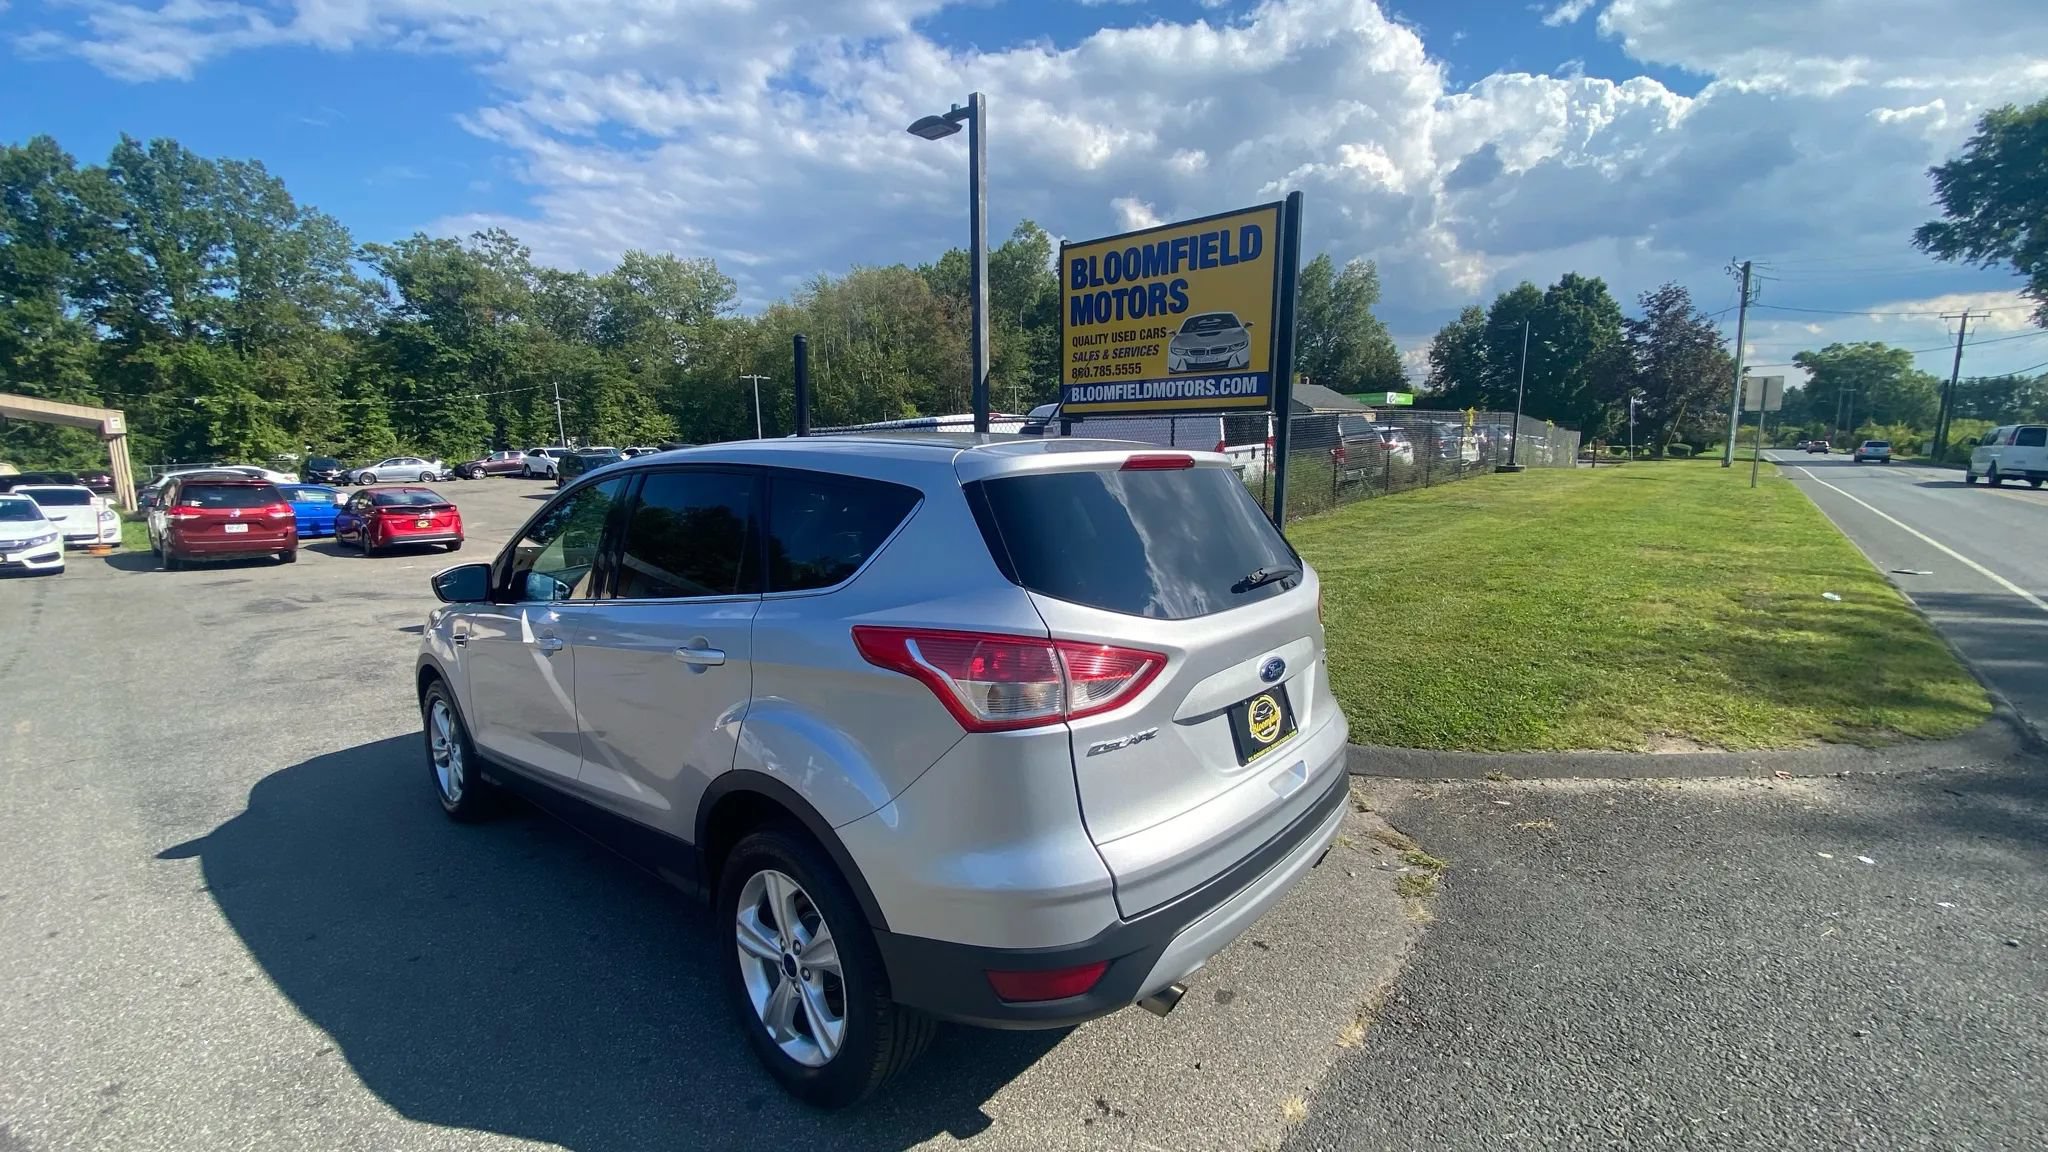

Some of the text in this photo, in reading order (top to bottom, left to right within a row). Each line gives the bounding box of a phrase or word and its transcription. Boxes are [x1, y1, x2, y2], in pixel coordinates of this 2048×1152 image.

[1071, 224, 1263, 291] BLOOMFIELD
[1070, 278, 1189, 327] MOTORS
[1072, 327, 1167, 347] QUALITY USED CARS
[1072, 344, 1160, 363] SALES & SERVICES
[1071, 376, 1258, 402] BLOOMFIELDMOTORS.COM
